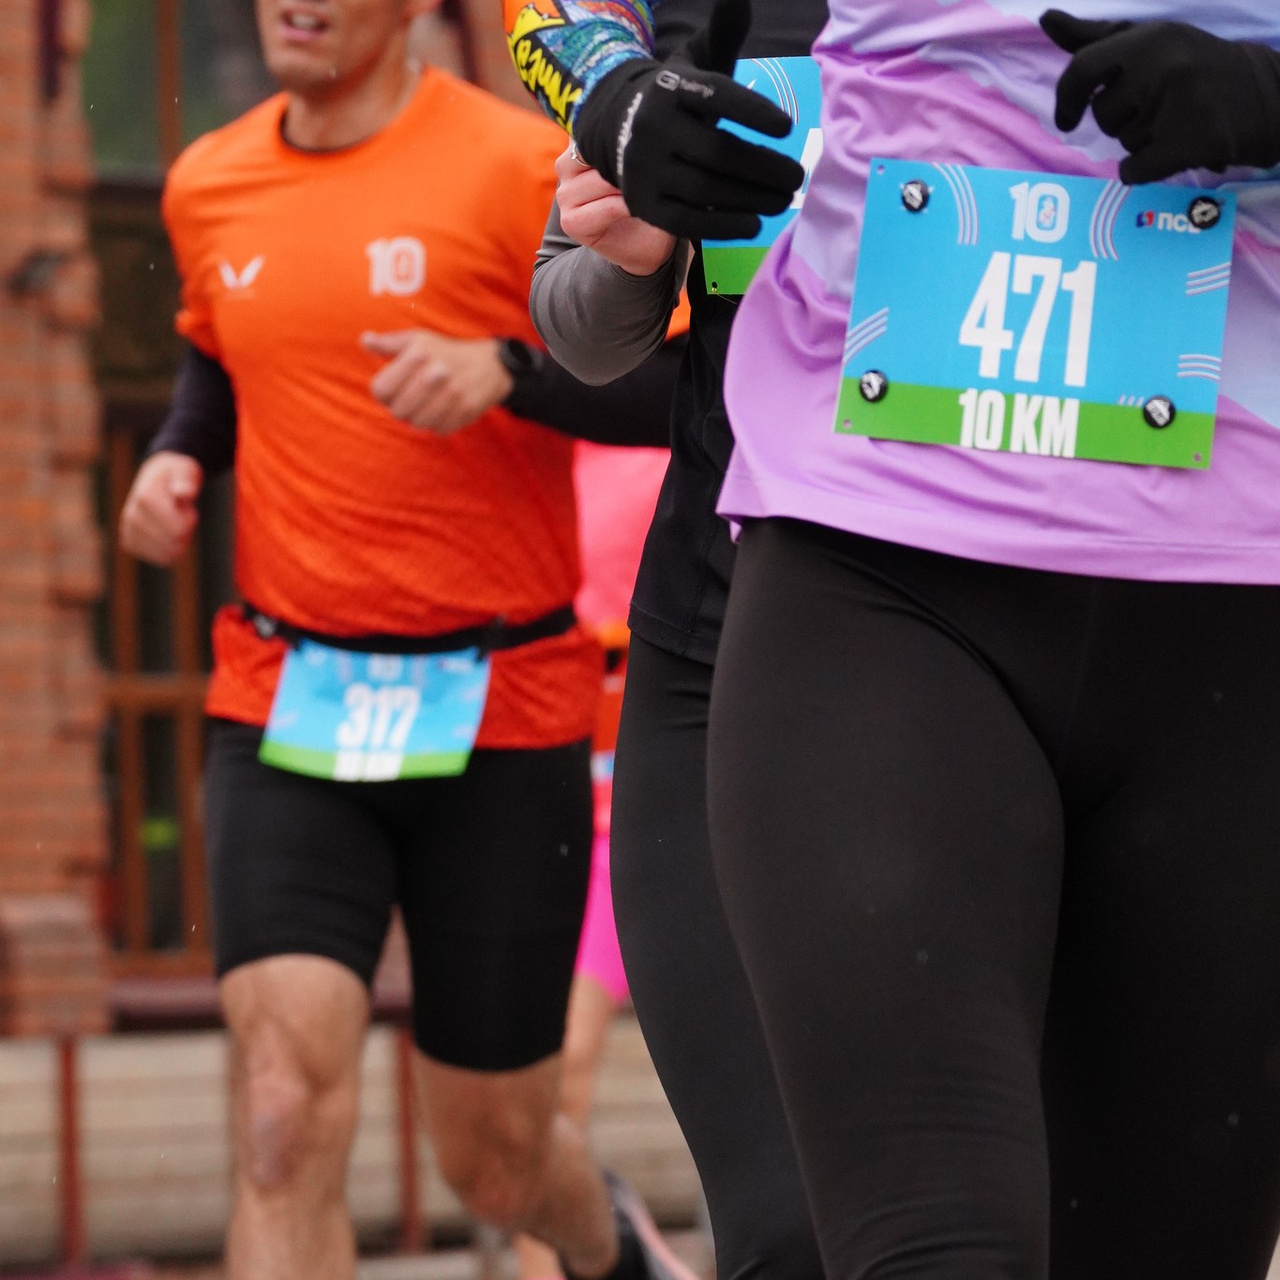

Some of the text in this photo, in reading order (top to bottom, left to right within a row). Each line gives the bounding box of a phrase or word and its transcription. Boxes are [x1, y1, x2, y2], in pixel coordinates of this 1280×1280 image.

[1009, 181, 1070, 243] 10
[366, 236, 427, 296] 10
[959, 251, 1097, 387] 471
[959, 388, 1080, 458] 10 KM
[336, 683, 421, 747] 317
